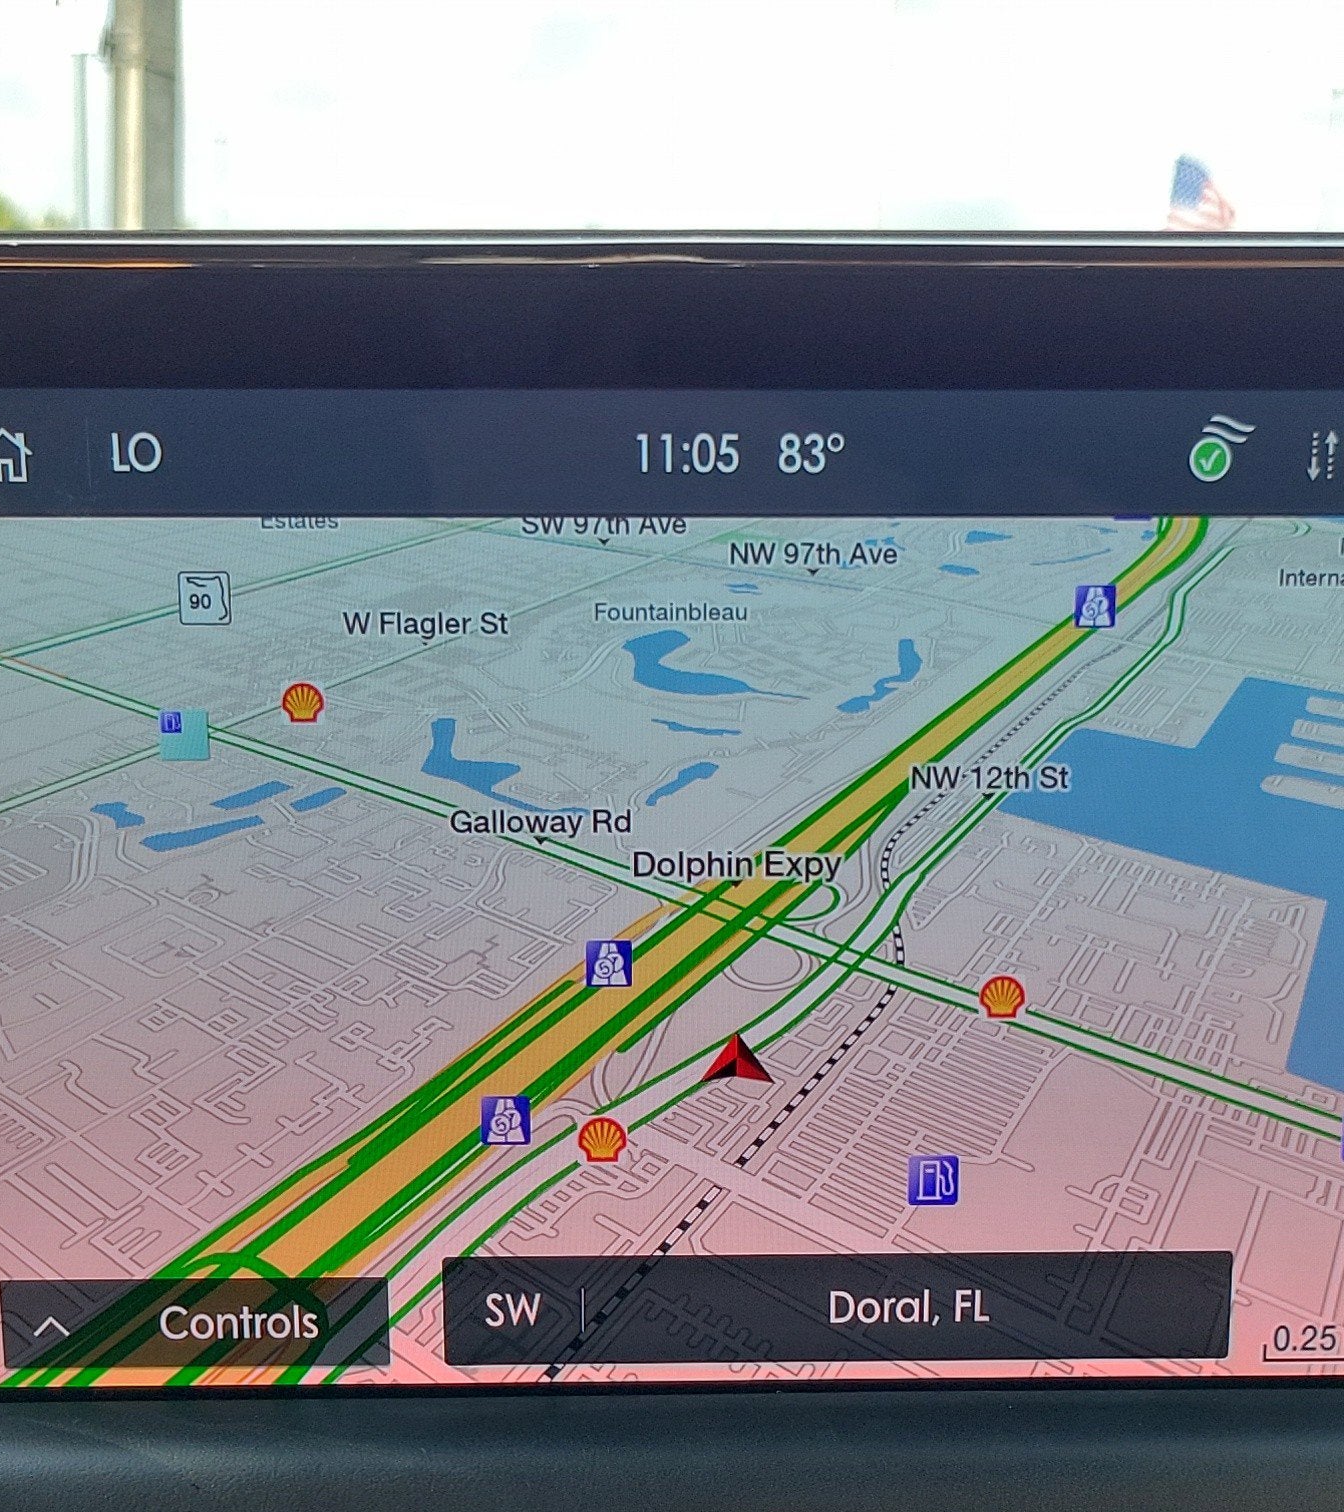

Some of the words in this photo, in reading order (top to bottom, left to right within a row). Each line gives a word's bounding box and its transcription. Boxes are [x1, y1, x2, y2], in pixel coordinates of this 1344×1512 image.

[111, 432, 162, 472] LO
[636, 433, 739, 473] 11:05
[778, 433, 845, 473] 83°
[522, 516, 564, 534] SW
[574, 516, 630, 534] 97th
[638, 516, 687, 534] Ave
[730, 542, 775, 566] NW
[782, 542, 841, 567] 97th
[848, 542, 897, 567] Ave
[189, 593, 212, 610] 90
[594, 602, 748, 622] Fountainbleau
[343, 612, 370, 634] W
[380, 611, 472, 641] Flagler
[480, 611, 508, 634] St
[911, 766, 959, 790] NW
[968, 766, 1029, 790] 12th
[1036, 766, 1069, 790] St
[450, 810, 582, 843] Galloway
[592, 810, 631, 834] Rd
[633, 850, 754, 884] Dolphin
[763, 851, 841, 882] Expy
[160, 1305, 319, 1341] Controls
[485, 1293, 541, 1327] SW
[829, 1290, 941, 1327] Doral,
[954, 1291, 991, 1323] FL
[1274, 1325, 1336, 1352] 0.25
